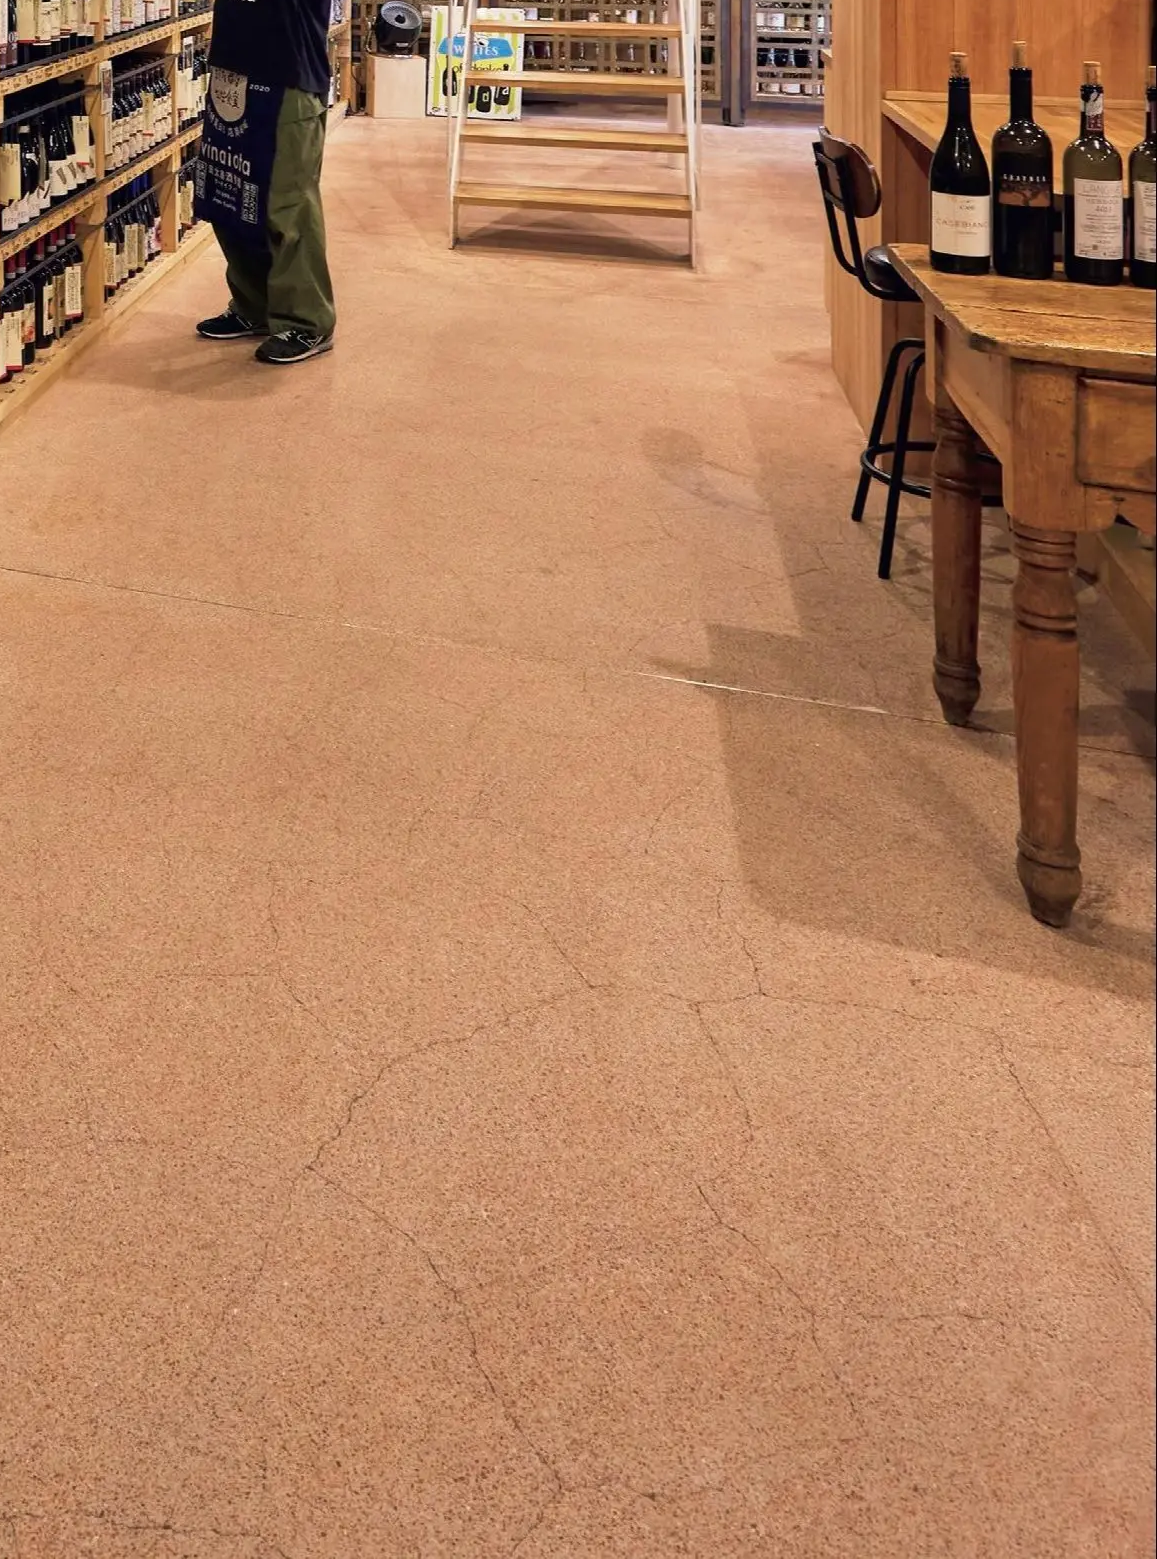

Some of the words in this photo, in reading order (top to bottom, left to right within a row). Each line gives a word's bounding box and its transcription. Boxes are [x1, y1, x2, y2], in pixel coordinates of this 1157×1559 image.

[454, 44, 499, 56] WITES
[249, 83, 271, 93] 2020
[200, 137, 252, 177] vinaiota
